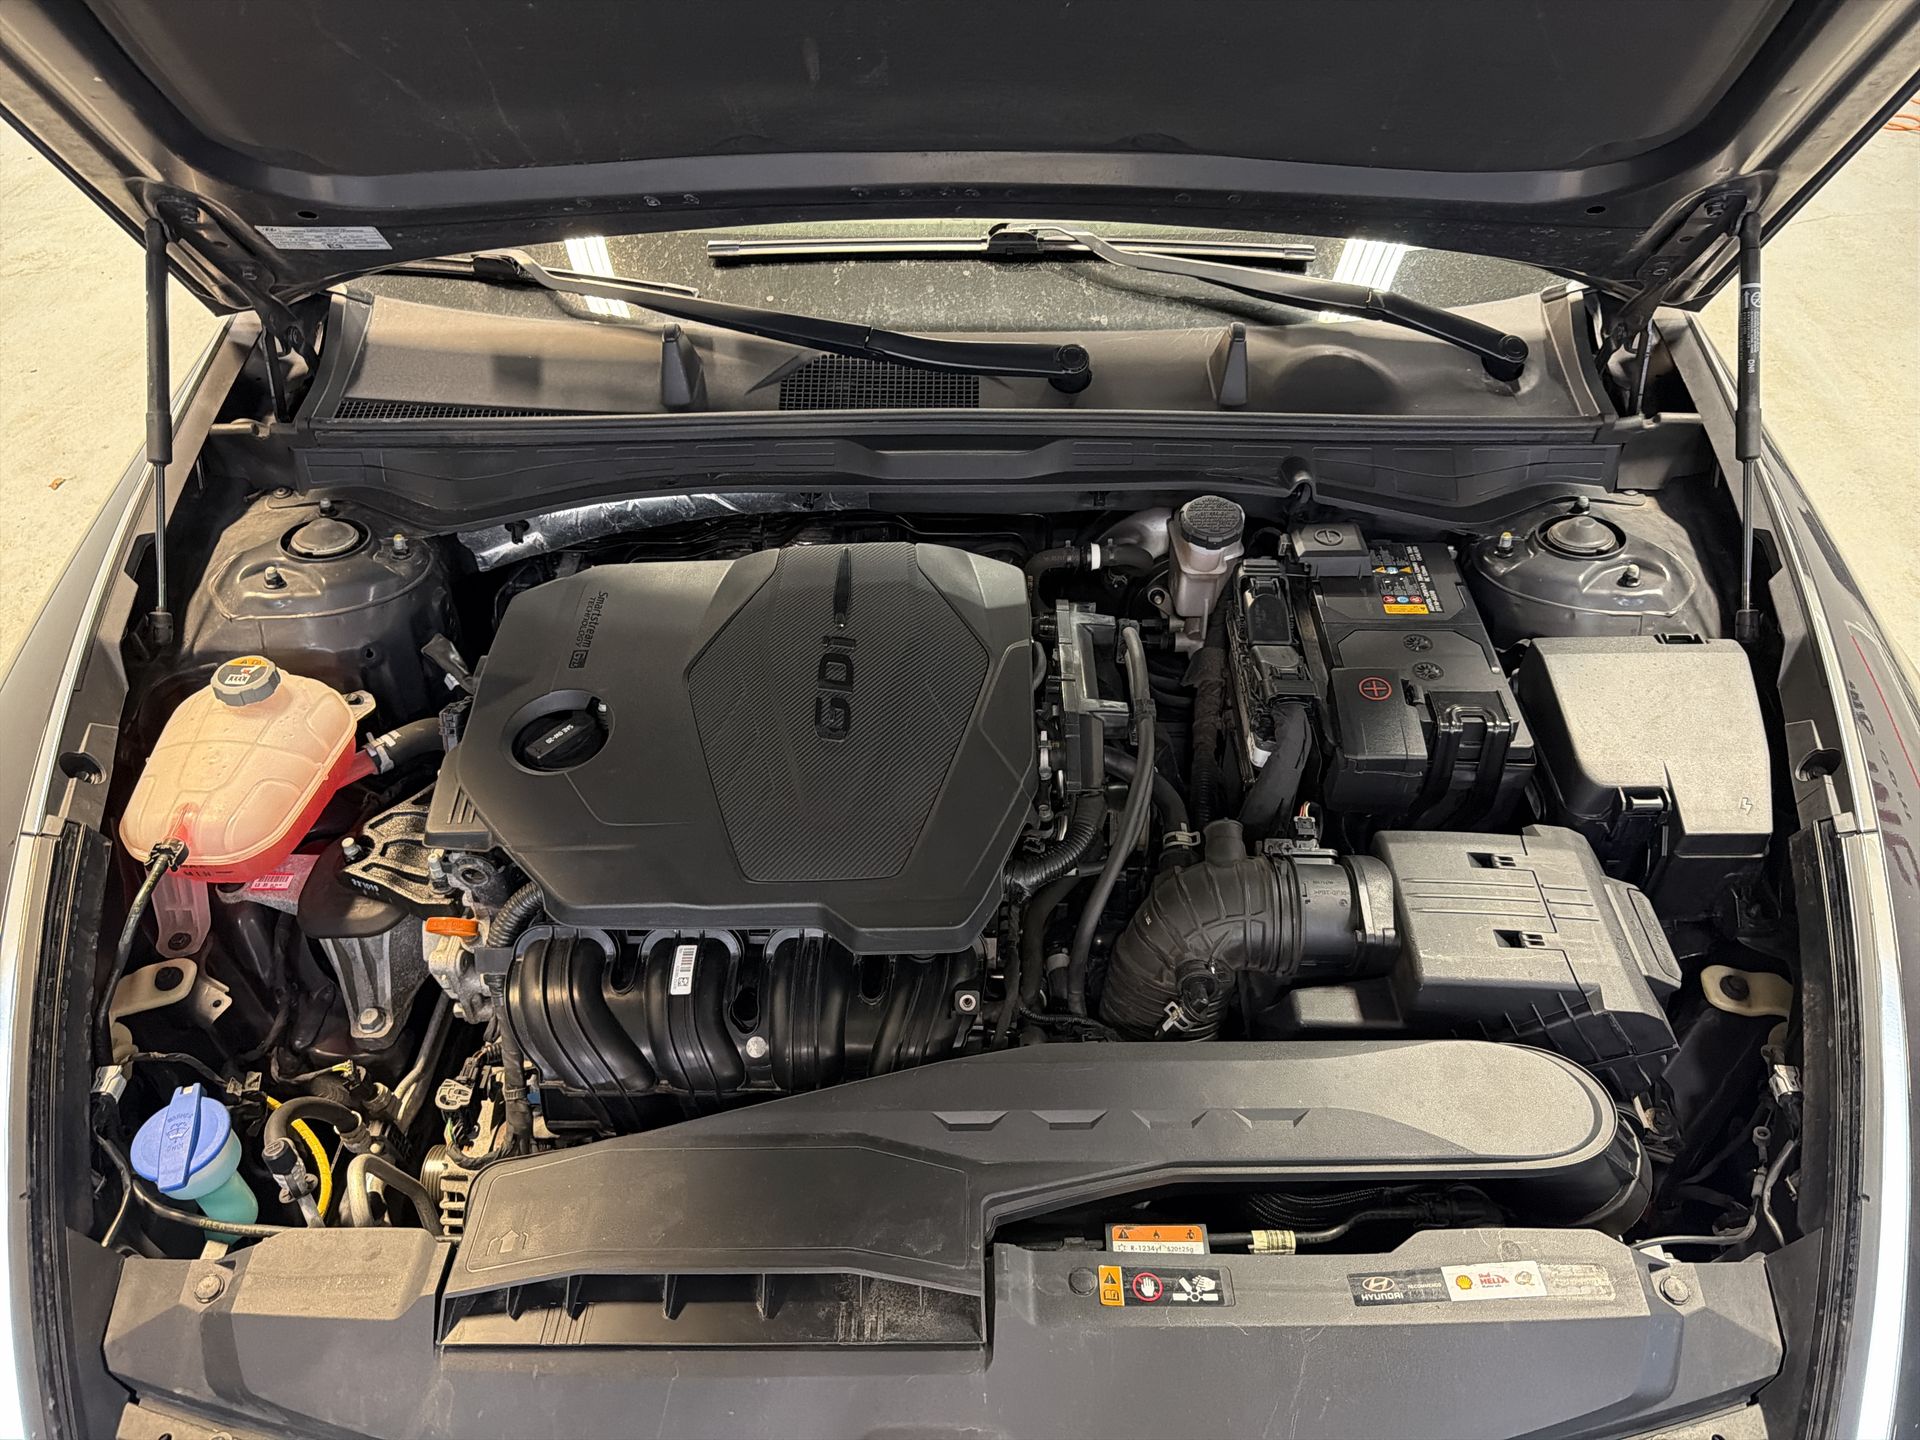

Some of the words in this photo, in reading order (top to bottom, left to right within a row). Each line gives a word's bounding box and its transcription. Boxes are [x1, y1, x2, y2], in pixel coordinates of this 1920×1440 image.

[1747, 359, 1755, 374] DN8
[575, 596, 597, 648] TECHNOLOGY
[582, 590, 609, 648] Smartstream
[814, 636, 856, 741] GDi
[1361, 1292, 1404, 1300] HYUNDAI
[1480, 1275, 1509, 1285] HELIX
